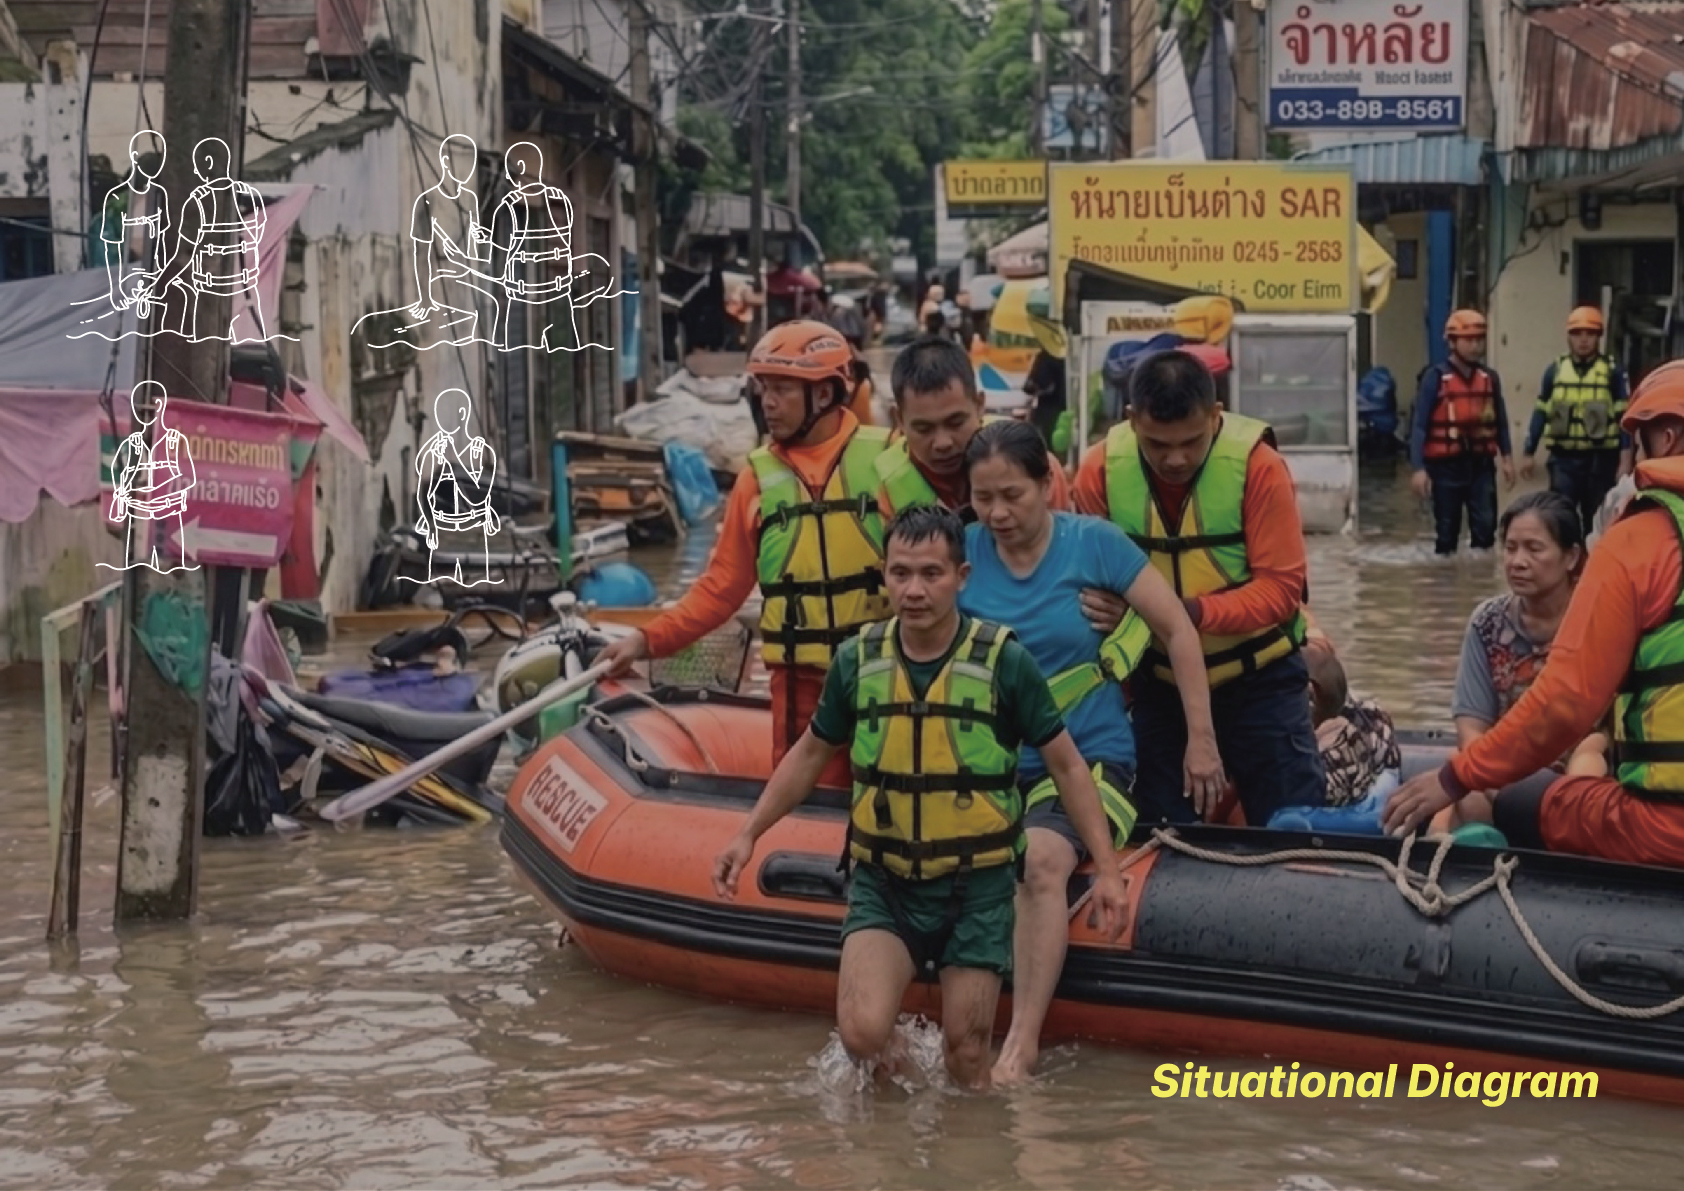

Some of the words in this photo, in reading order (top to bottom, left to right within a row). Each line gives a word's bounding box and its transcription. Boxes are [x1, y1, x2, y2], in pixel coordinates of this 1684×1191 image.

[1280, 187, 1341, 218] SAR
[1253, 279, 1296, 299] Coor
[527, 764, 597, 842] RESCUE
